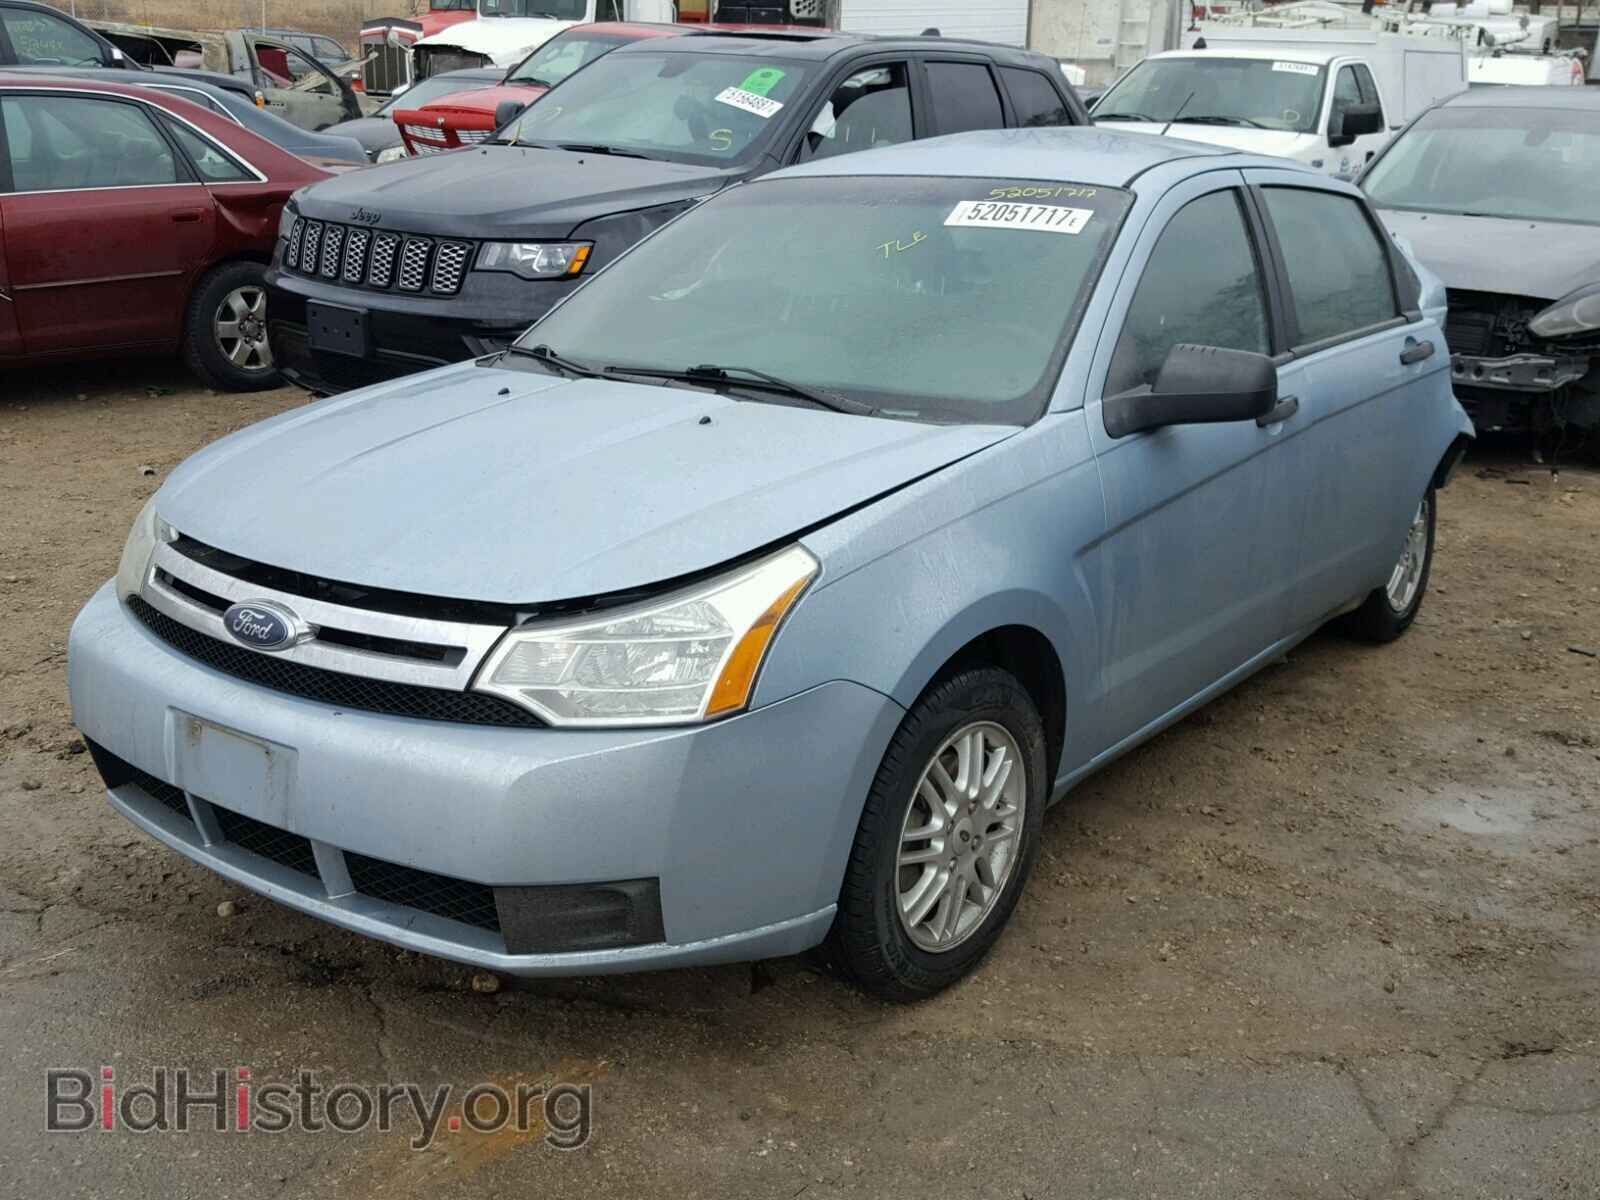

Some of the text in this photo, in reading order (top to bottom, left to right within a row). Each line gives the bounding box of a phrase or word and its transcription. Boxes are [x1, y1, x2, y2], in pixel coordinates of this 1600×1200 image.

[987, 186, 1097, 201] 52051717
[350, 206, 382, 226] Jeep
[967, 202, 1073, 226] 52051717
[232, 608, 275, 640] Ford
